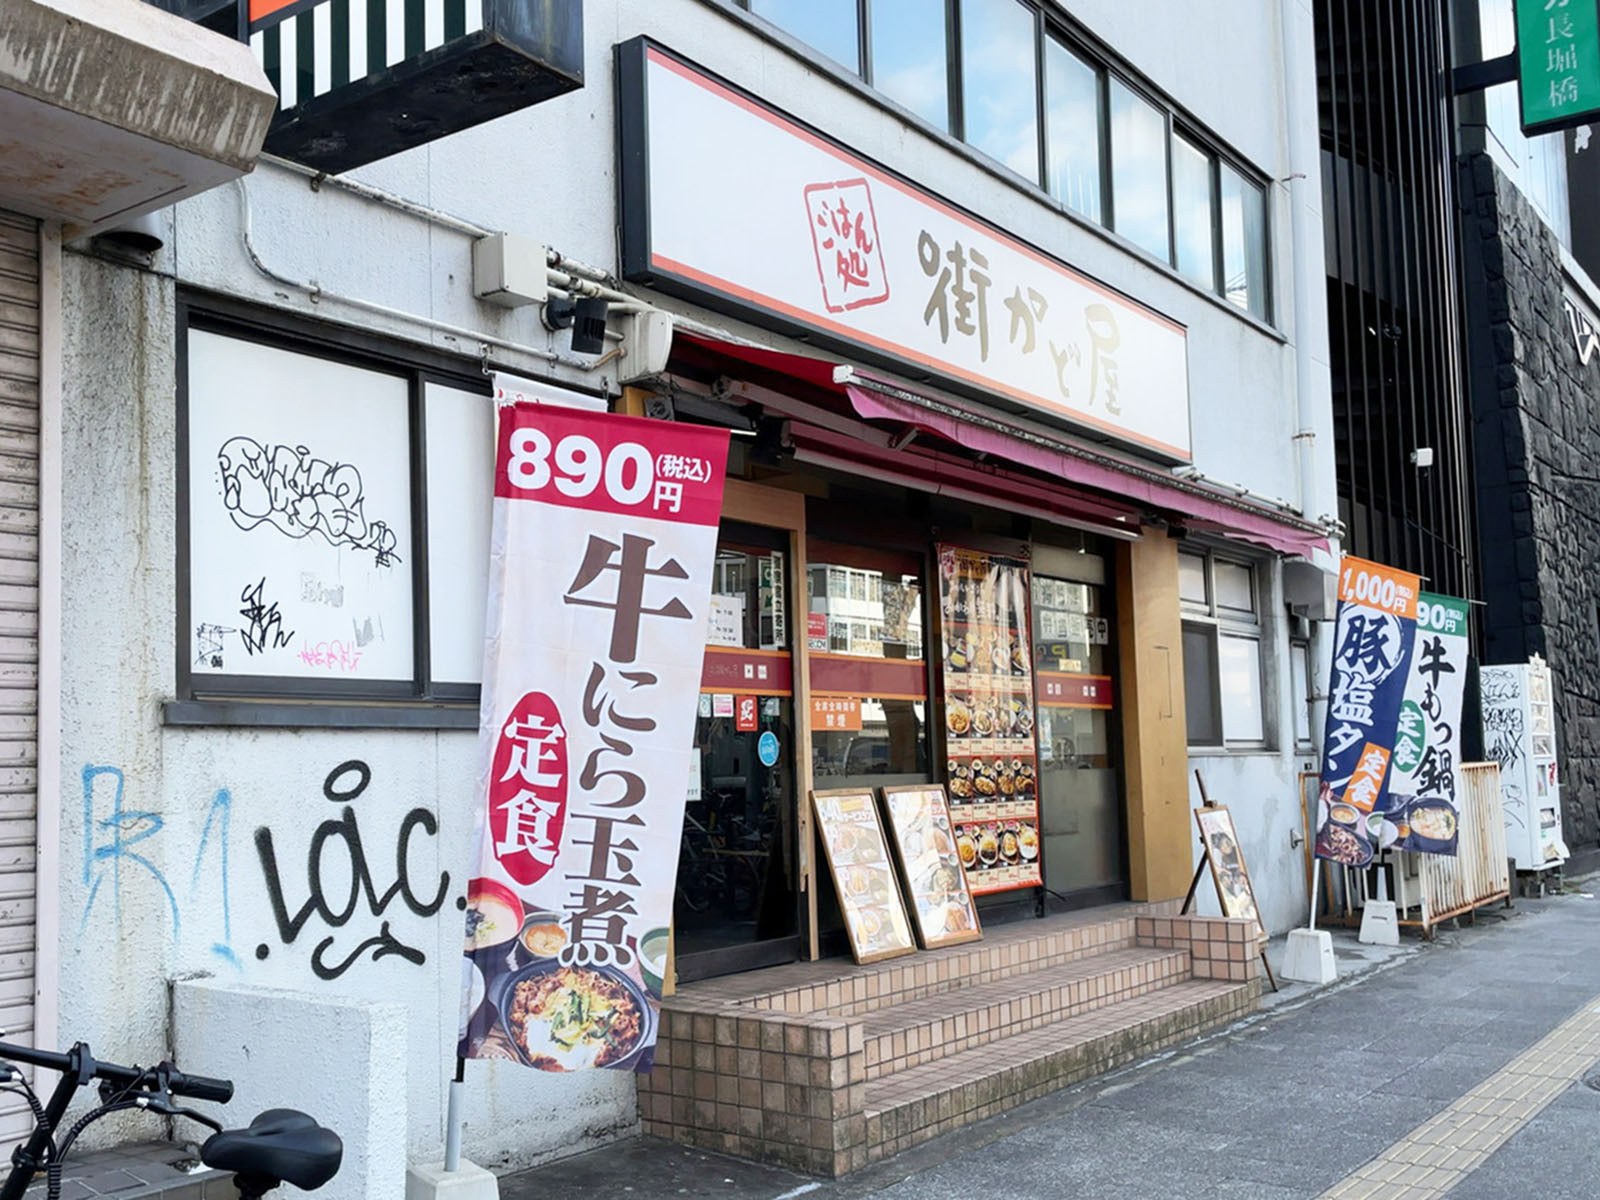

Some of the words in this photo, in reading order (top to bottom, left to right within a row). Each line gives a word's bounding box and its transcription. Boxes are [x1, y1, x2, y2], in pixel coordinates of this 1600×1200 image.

[917, 229, 1122, 417] 街かど屋
[655, 453, 713, 486] (税込)
[495, 714, 563, 866] 定食
[563, 530, 694, 967] 牛にら玉煮
[1348, 749, 1386, 806] 定食
[1394, 706, 1422, 767] 定食
[1412, 635, 1457, 802] 牛もつ鍋
